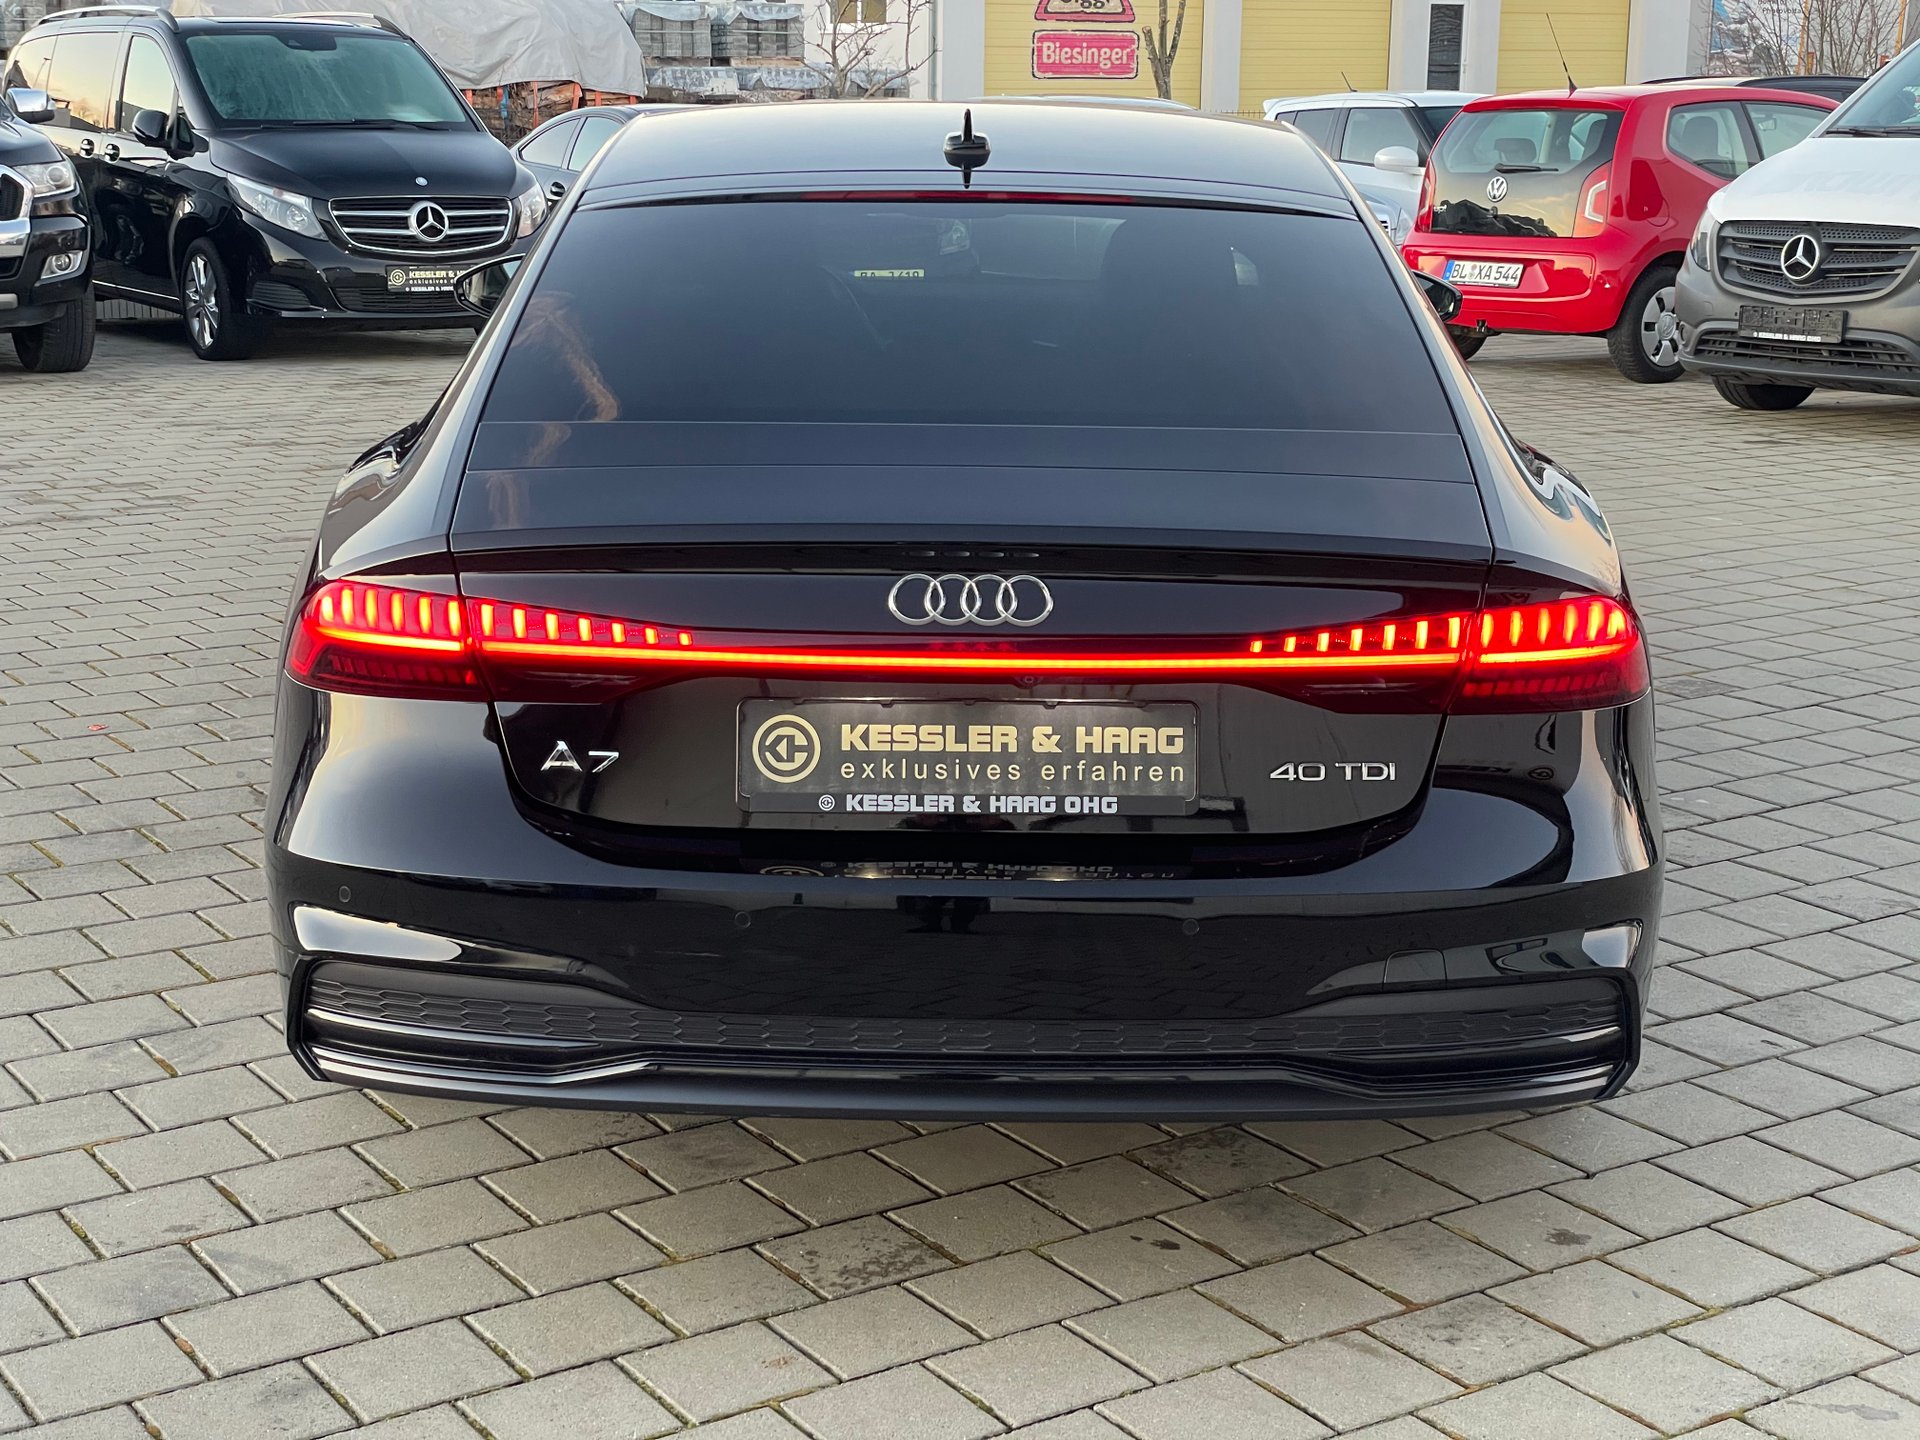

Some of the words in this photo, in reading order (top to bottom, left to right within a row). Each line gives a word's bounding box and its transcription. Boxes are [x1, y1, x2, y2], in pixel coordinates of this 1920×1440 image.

[1042, 42, 1130, 69] Biesinger
[409, 270, 446, 278] KESSLER
[1451, 263, 1467, 279] BL
[1475, 265, 1493, 280] XA
[1494, 266, 1520, 282] 544
[841, 724, 1017, 752] KESSLER
[1032, 725, 1062, 753] &
[1076, 726, 1183, 754] HAAG
[540, 740, 619, 773] A7
[841, 758, 1021, 780] exklusives
[1041, 760, 1184, 782] erfahren
[1270, 763, 1326, 781] 40
[1335, 763, 1396, 781] TDI
[846, 794, 955, 812] KESSLER
[962, 795, 982, 813] &
[990, 796, 1057, 813] HAAG
[1064, 796, 1118, 814] OHG
